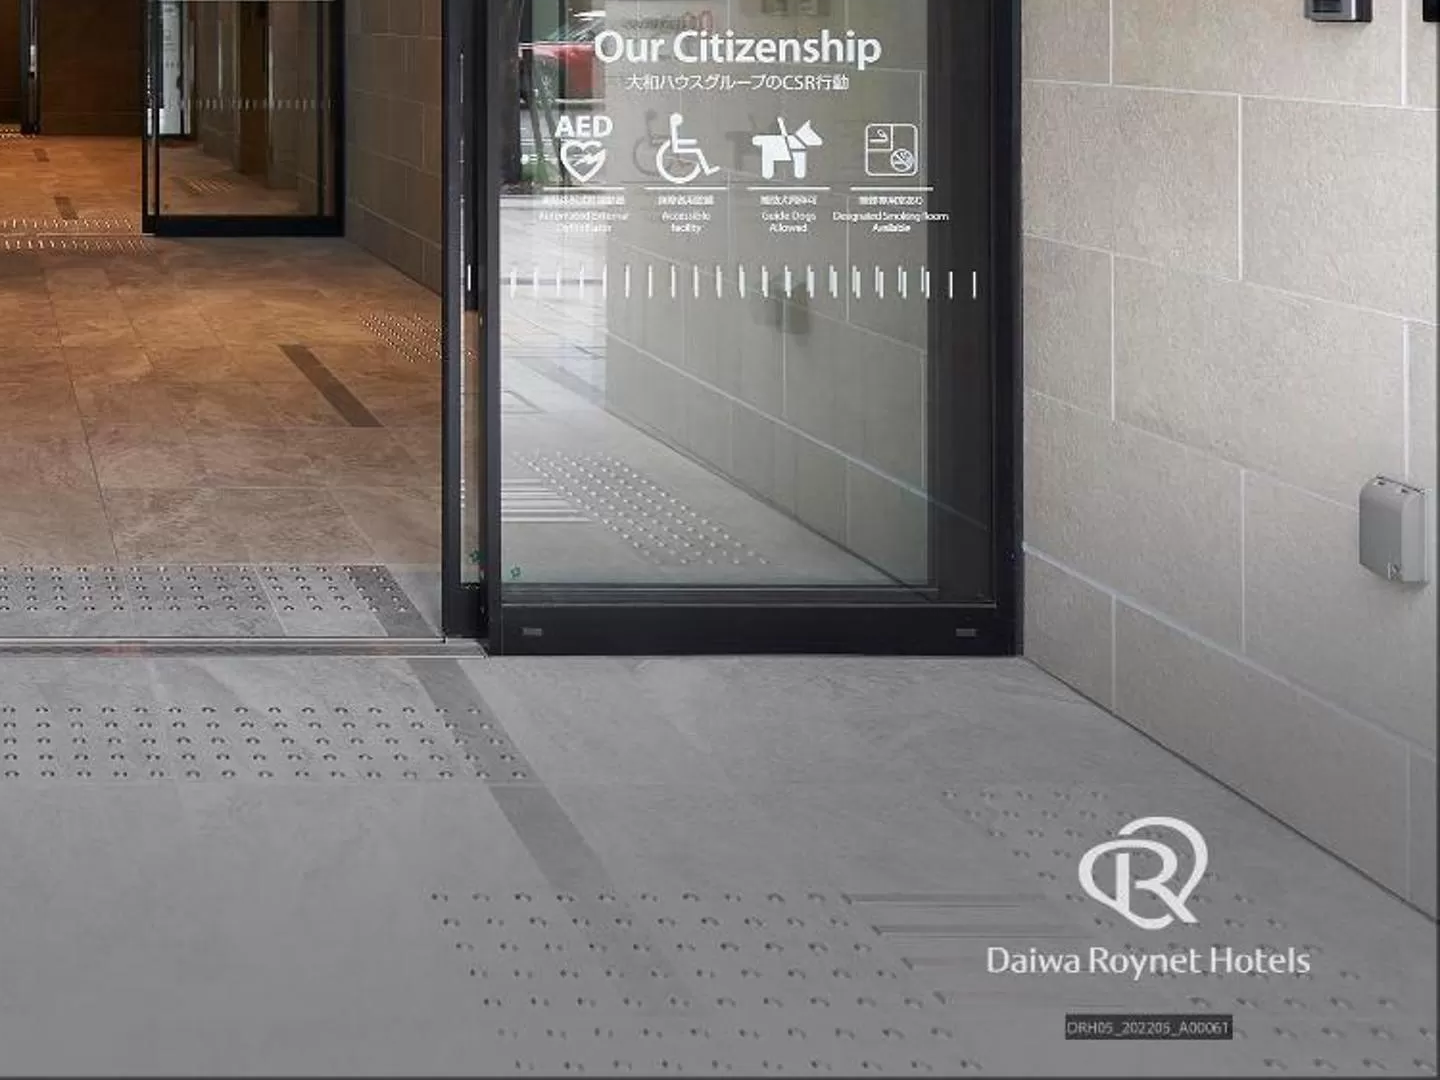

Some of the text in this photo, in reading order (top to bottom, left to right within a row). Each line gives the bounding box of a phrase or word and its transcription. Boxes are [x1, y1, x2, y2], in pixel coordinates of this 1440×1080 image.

[594, 30, 882, 70] Our Citizenship
[626, 73, 850, 91] 大和ハウスグループのCSR行動
[555, 116, 614, 138] AED
